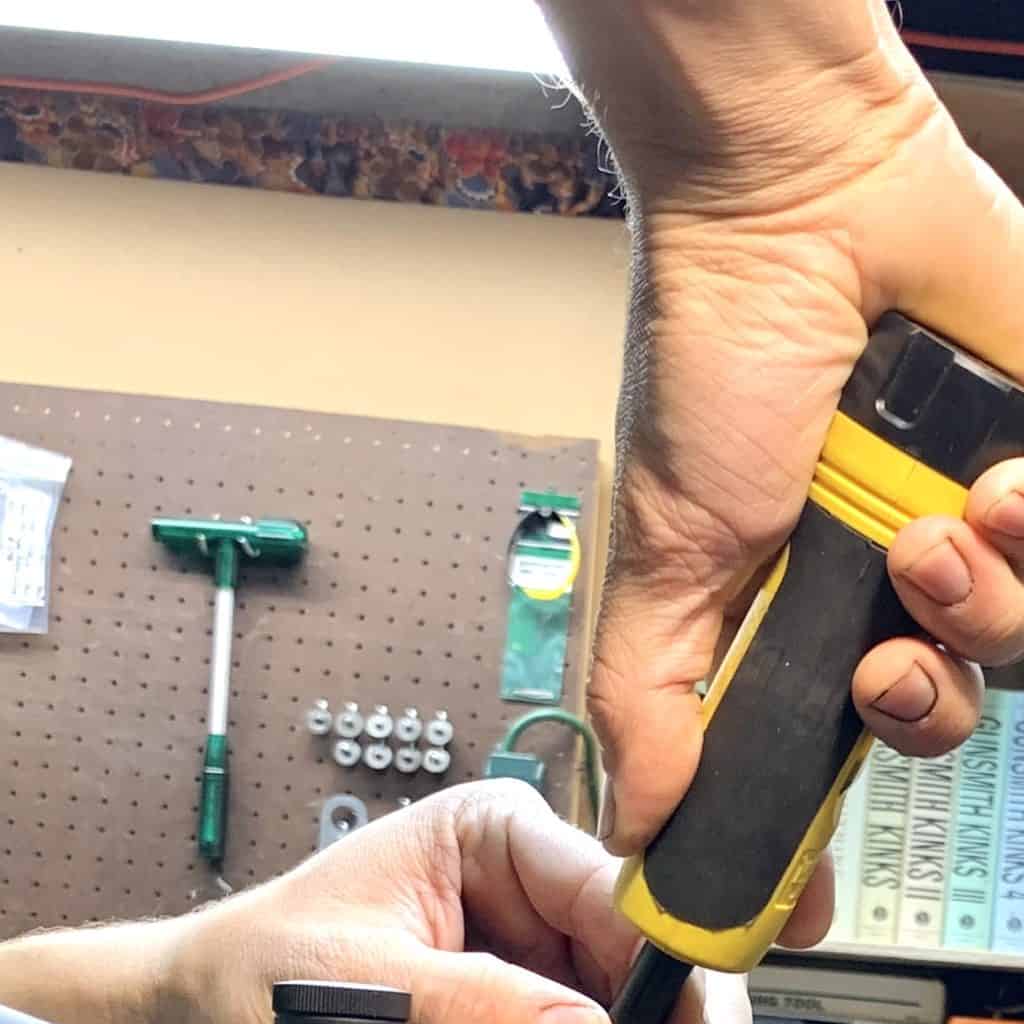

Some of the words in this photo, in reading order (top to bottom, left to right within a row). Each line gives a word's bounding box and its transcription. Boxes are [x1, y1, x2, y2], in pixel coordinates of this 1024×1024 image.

[870, 743, 911, 813] SMITH
[914, 751, 955, 811] SMITH
[959, 715, 1001, 817] GUNSMITH
[862, 824, 904, 890] KINKS
[907, 816, 949, 882] KINKS
[952, 823, 991, 879] KINKS
[905, 887, 940, 901] II
[951, 888, 985, 903] III
